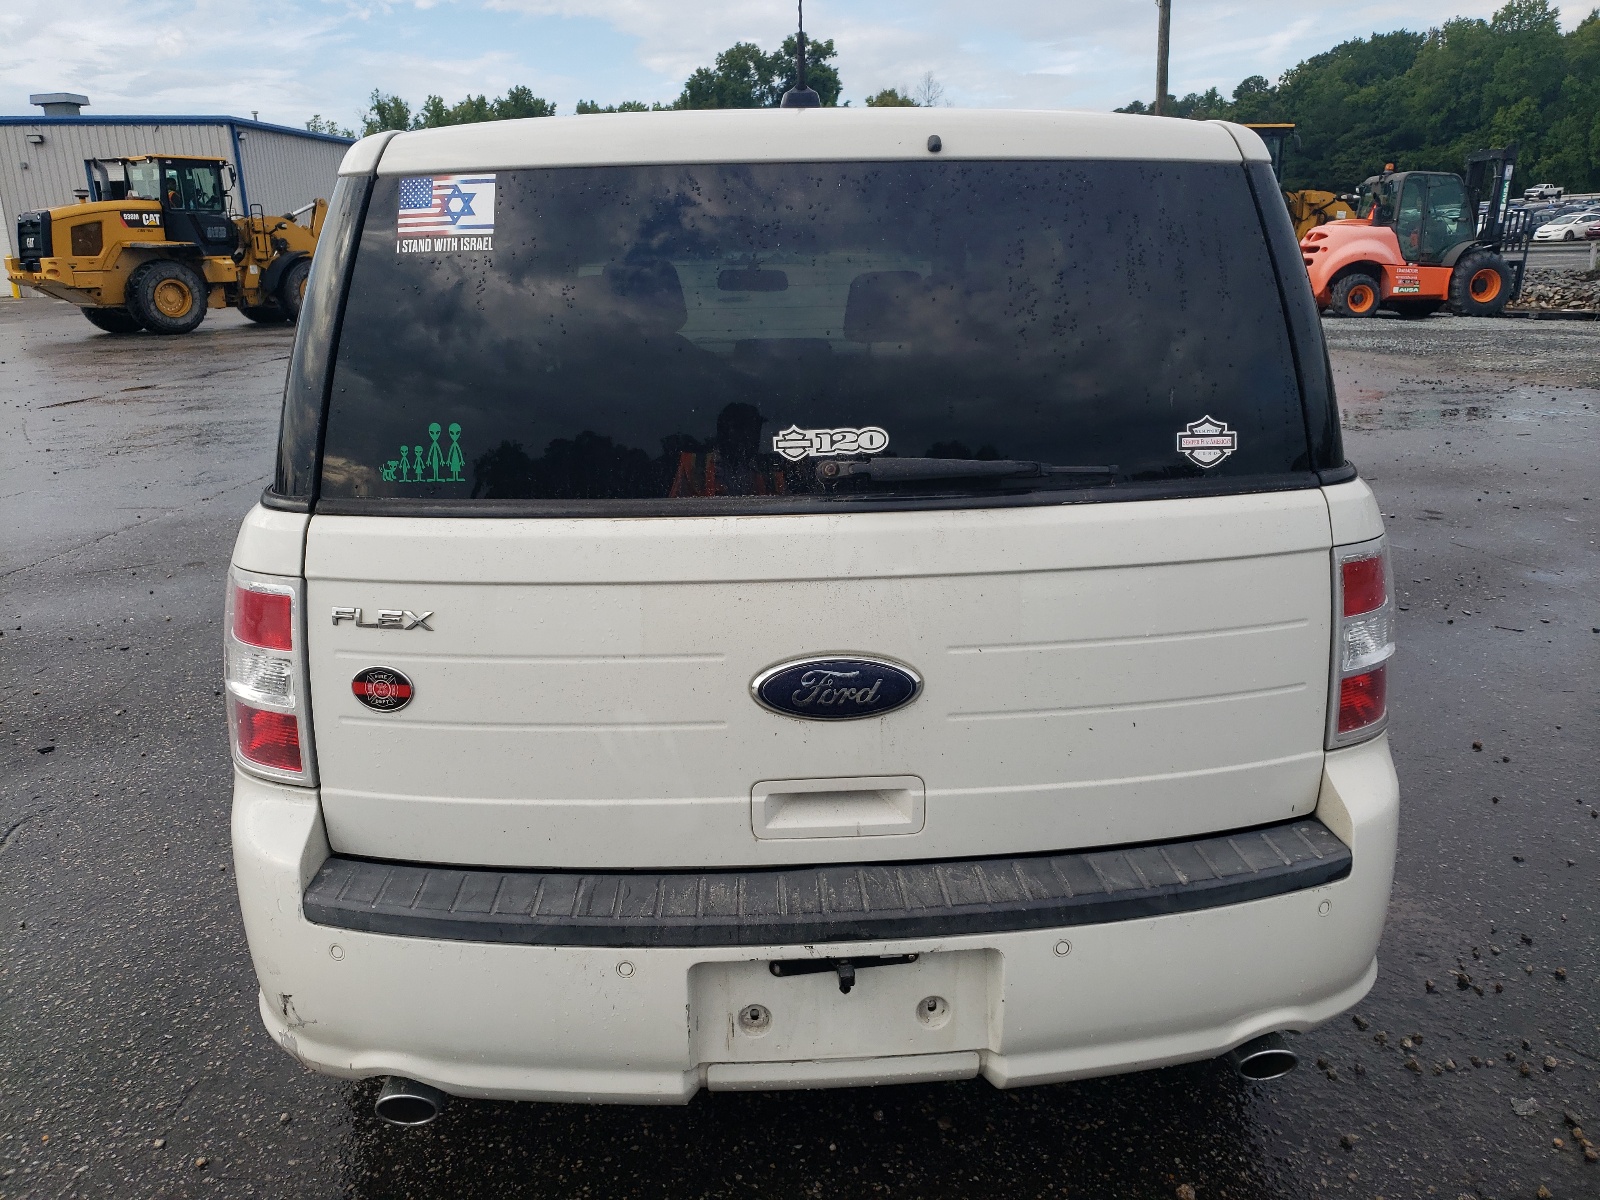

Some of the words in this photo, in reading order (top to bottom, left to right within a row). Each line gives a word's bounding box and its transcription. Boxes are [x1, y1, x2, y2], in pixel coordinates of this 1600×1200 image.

[142, 213, 160, 226] CAT
[396, 240, 400, 253] I
[402, 239, 431, 253] STAND
[434, 237, 458, 251] WITH
[460, 236, 493, 251] ISRAEL
[815, 430, 887, 453] 120
[331, 606, 435, 631] FLEX
[791, 669, 883, 706] Ford
